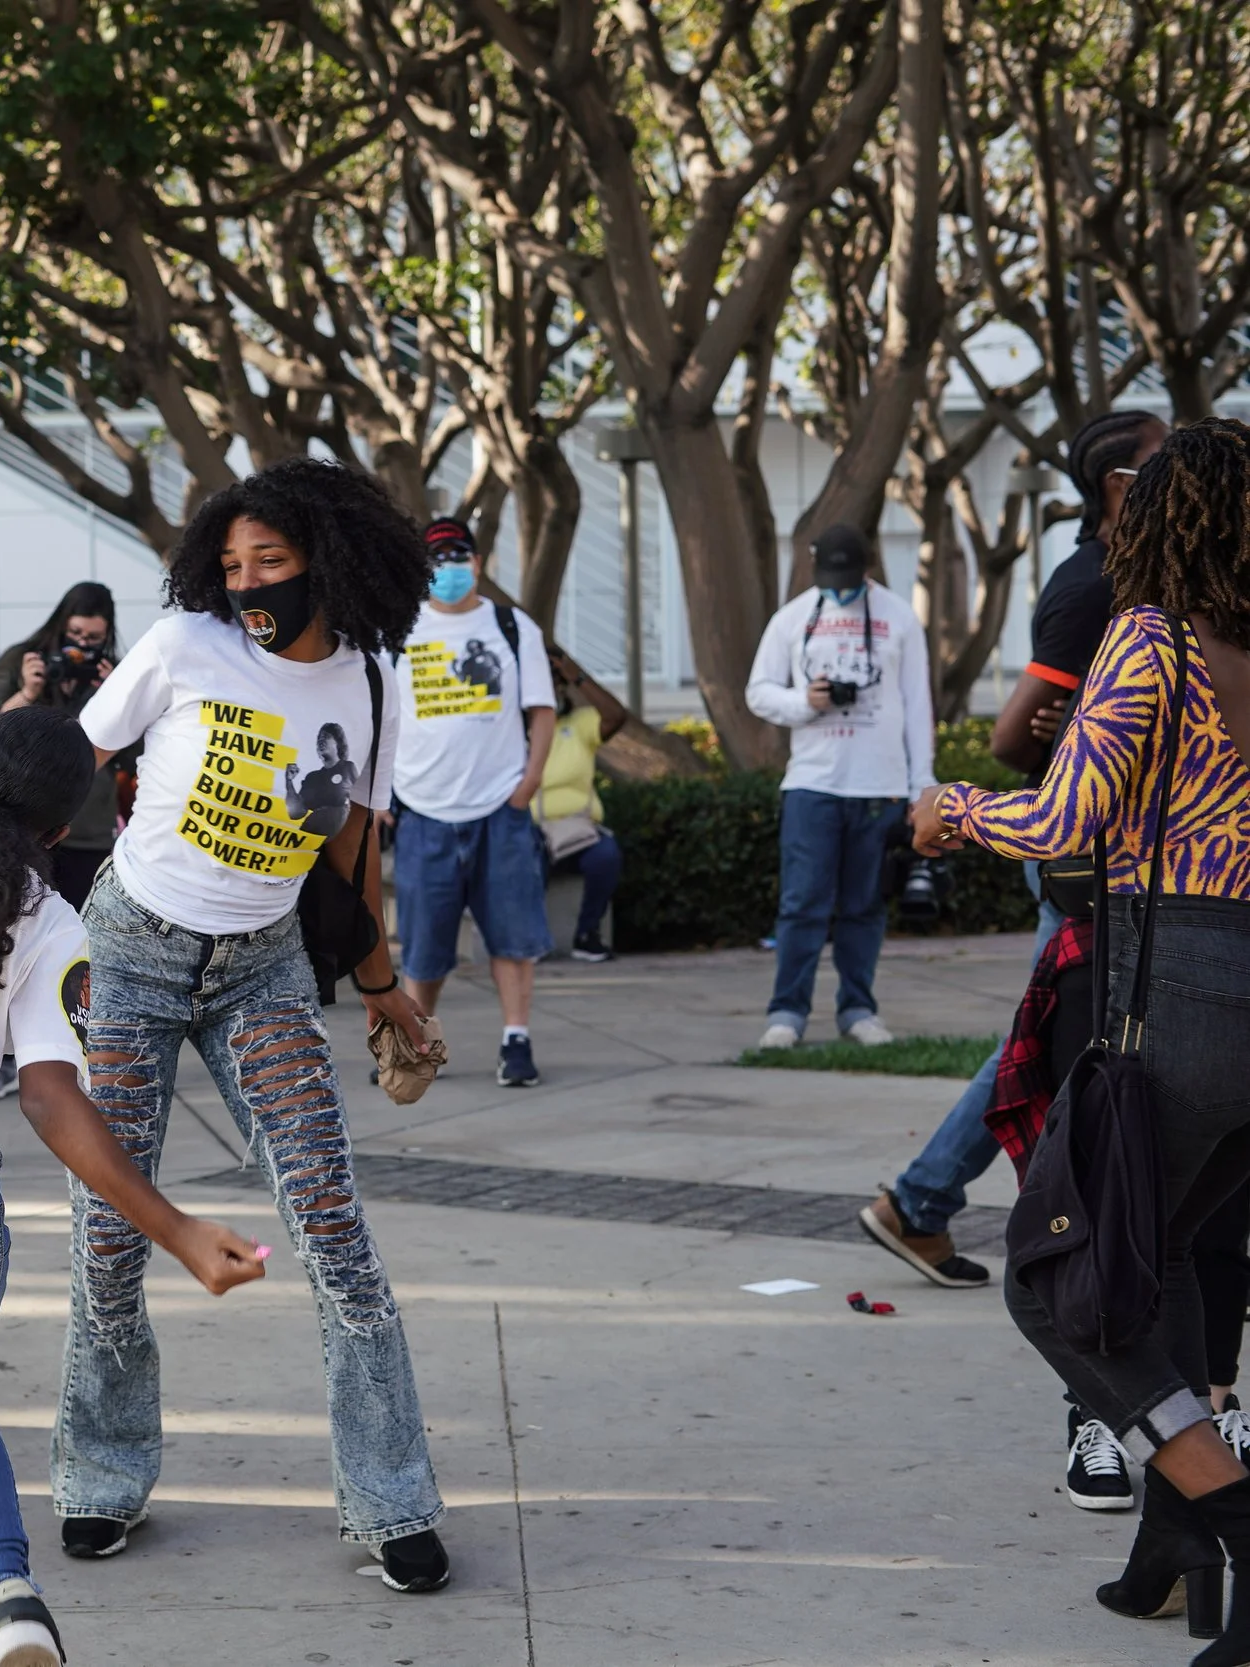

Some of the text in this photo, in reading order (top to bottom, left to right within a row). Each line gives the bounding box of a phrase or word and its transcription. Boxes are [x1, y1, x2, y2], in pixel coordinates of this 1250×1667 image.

[202, 701, 254, 728] "WE
[204, 751, 235, 775] TO
[209, 729, 275, 762] HAVE
[196, 773, 273, 814] BUILD
[189, 800, 307, 849] OUR OWN
[180, 817, 289, 873] POWER!"
